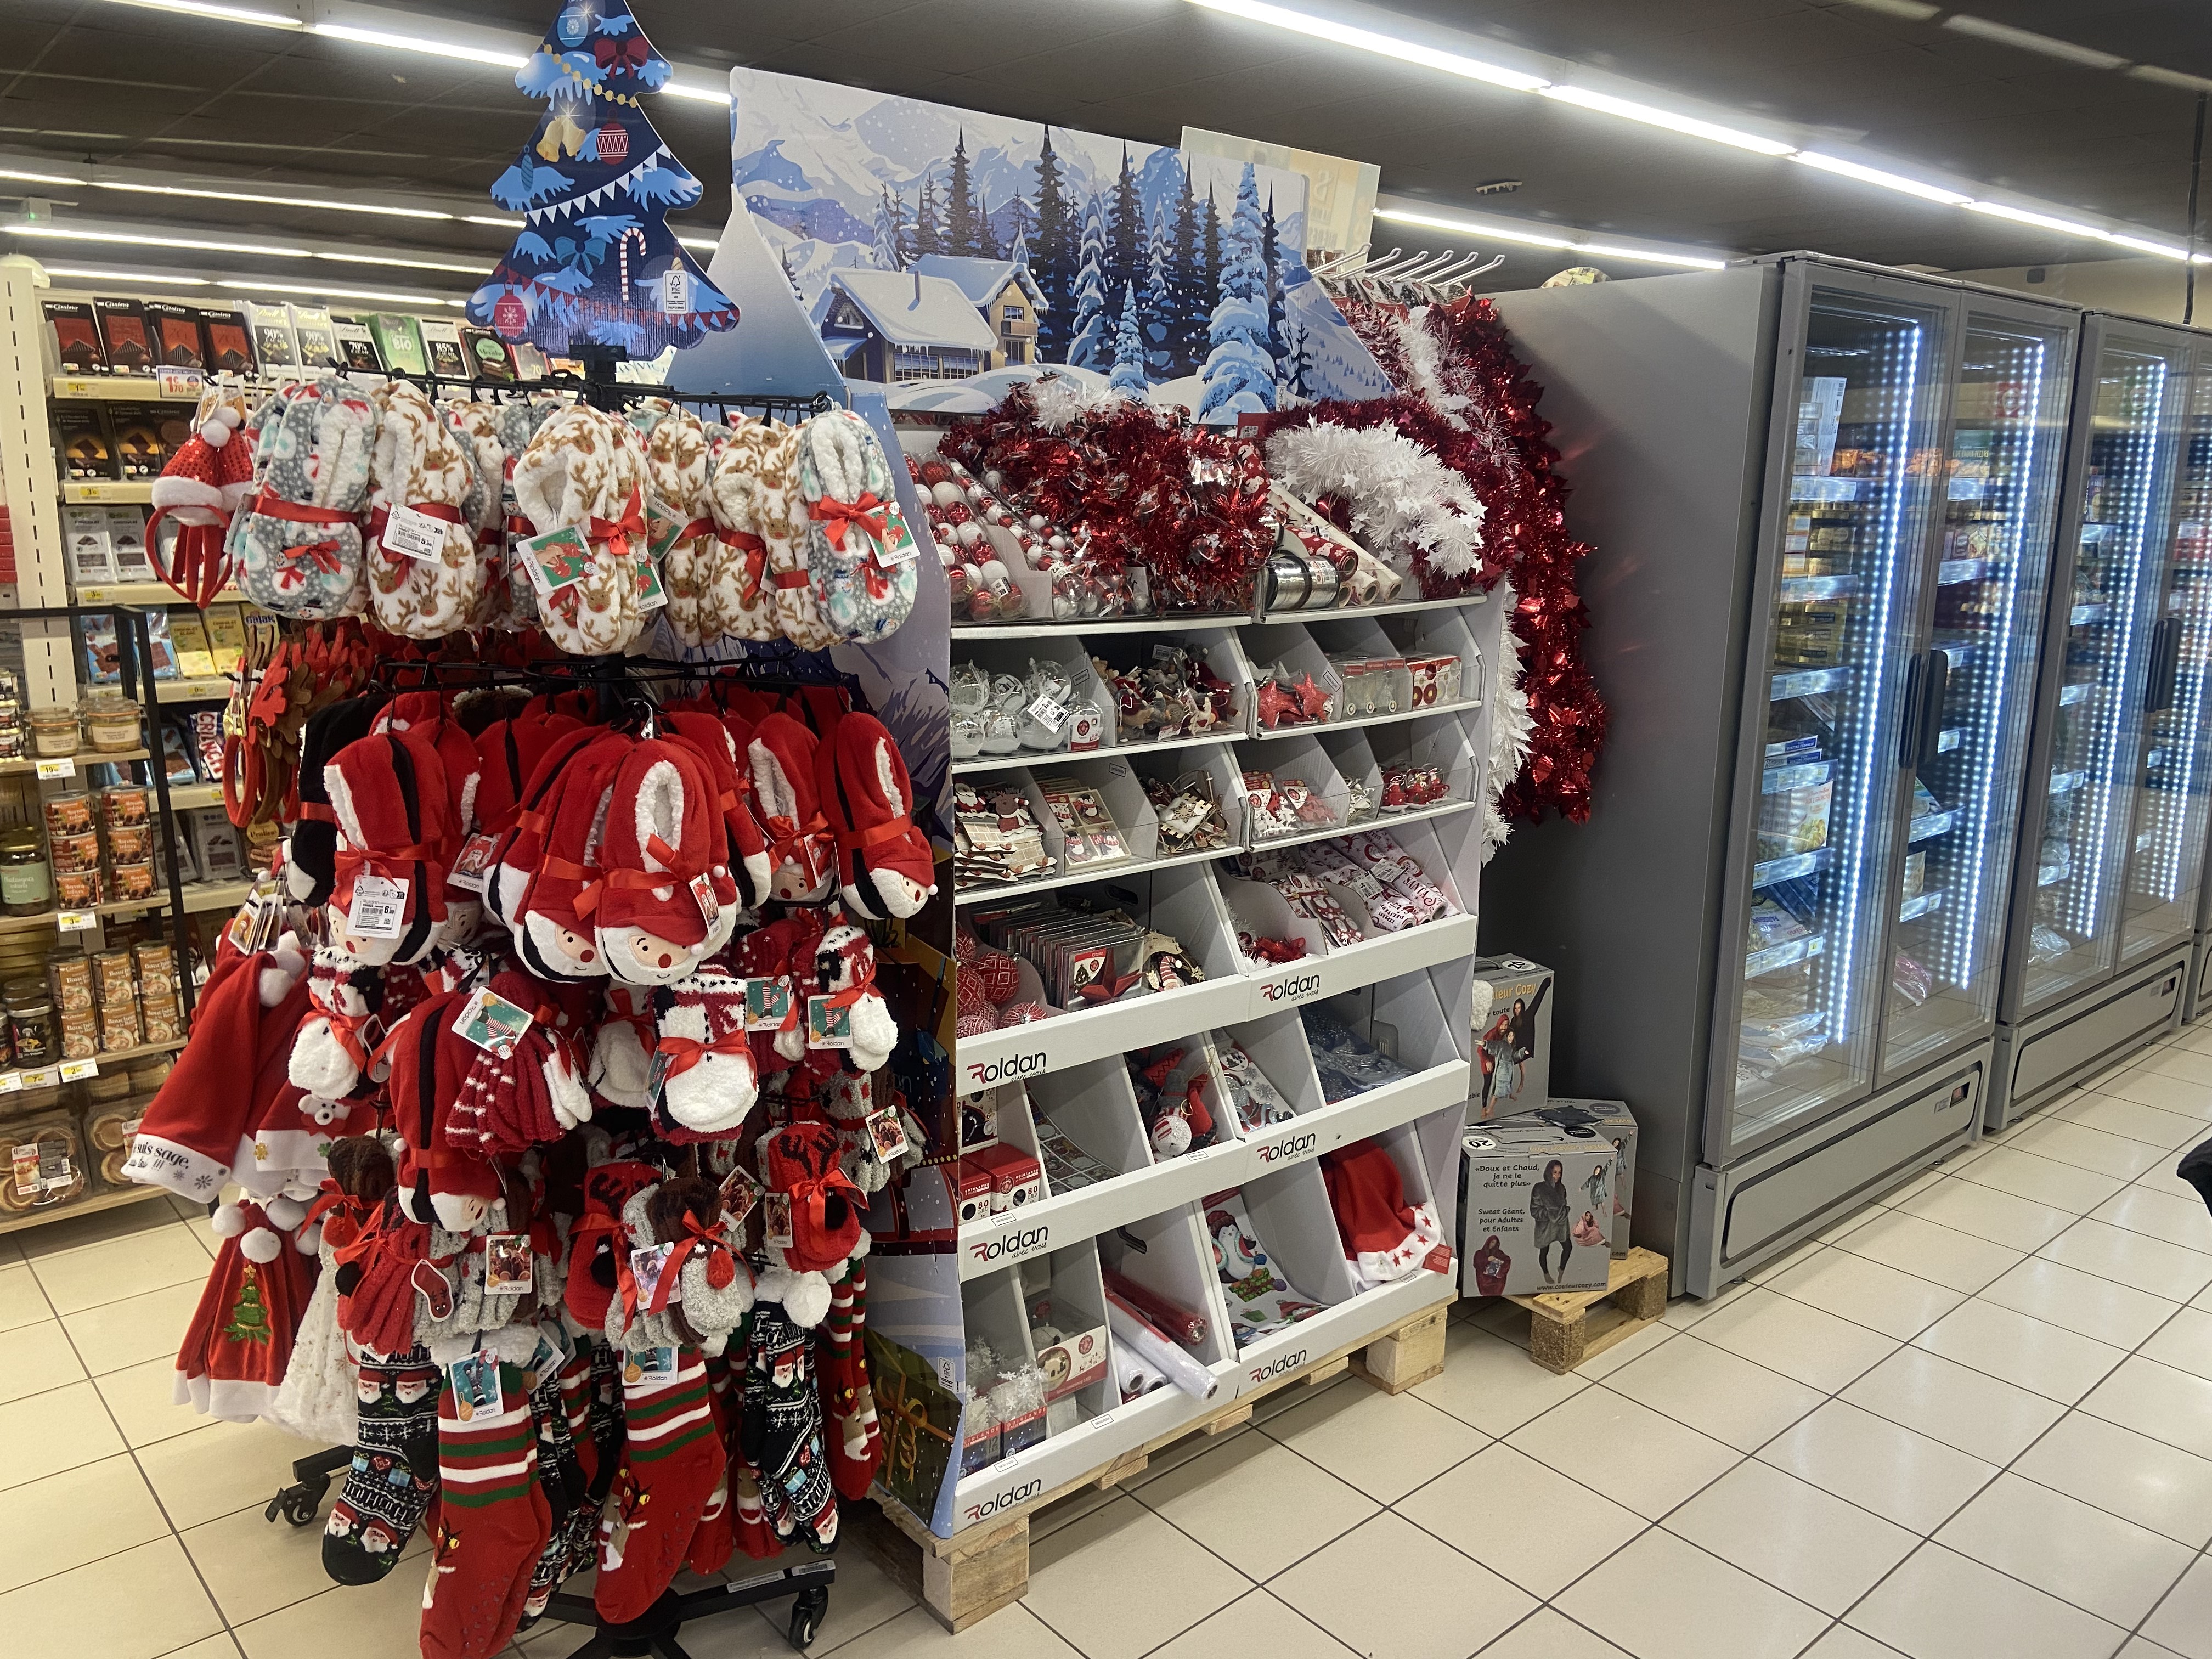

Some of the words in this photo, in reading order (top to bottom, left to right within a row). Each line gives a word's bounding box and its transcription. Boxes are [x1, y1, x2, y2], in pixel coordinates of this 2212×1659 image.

[393, 336, 413, 351] BIO
[894, 551, 912, 560] Roldan
[529, 560, 541, 583] Roldan
[246, 614, 276, 625] Galak
[1402, 877, 1430, 899] SANTA
[1260, 974, 1320, 1002] Roldan
[1515, 983, 1537, 997] Cozy
[1492, 1007, 1510, 1016] toute
[967, 1052, 1046, 1084] Roldan
[1256, 1133, 1316, 1163] Roldan
[154, 1147, 189, 1170] sage,
[1492, 1172, 1500, 1181] je
[1510, 1180, 1531, 1188] plus»
[1028, 1185, 1038, 1195] 80
[978, 1199, 989, 1210] 80
[969, 1226, 1048, 1262] Roldan
[1012, 1248, 1029, 1259] avec
[1031, 1241, 1048, 1251] vous
[1537, 1282, 1606, 1290] www.couleurcozy.com
[540, 1359, 557, 1375] Roldan
[1249, 1349, 1307, 1383] Roldan
[479, 1407, 496, 1415] Roldan
[1007, 1407, 1046, 1428] GUIRLANDE
[963, 1479, 1041, 1520] Roldan
